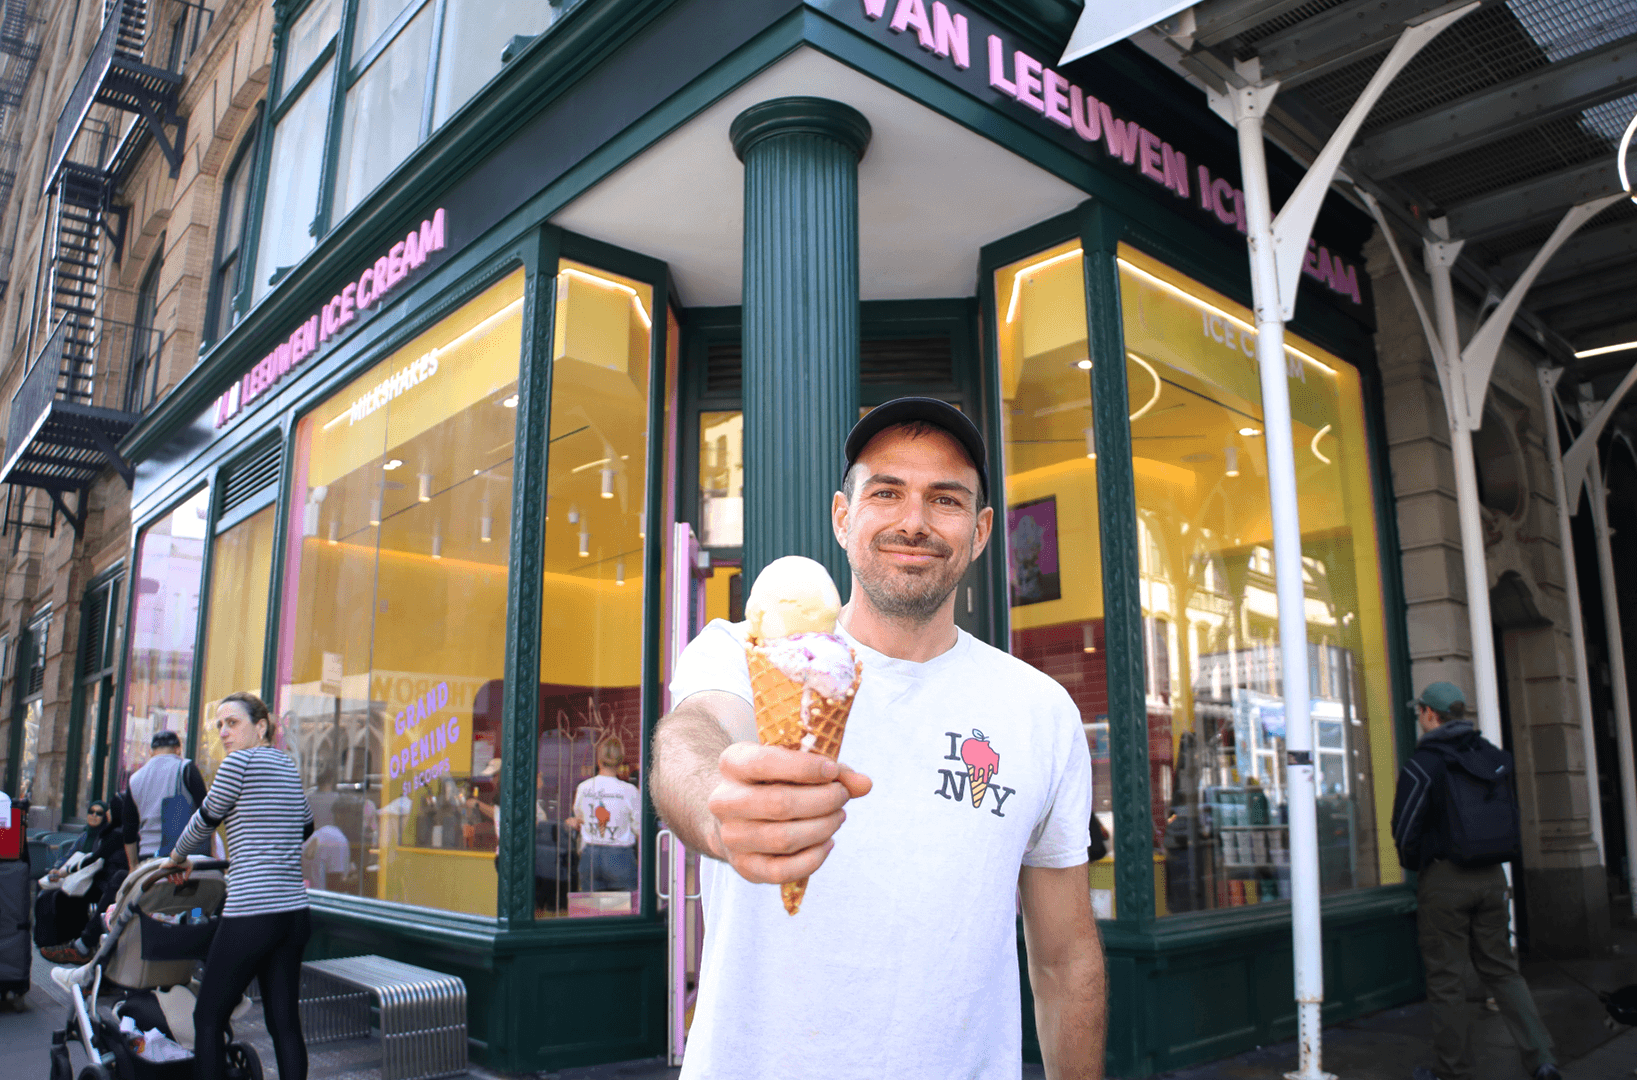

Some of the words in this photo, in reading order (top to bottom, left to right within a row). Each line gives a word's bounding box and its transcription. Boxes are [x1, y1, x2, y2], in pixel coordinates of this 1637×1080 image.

[987, 34, 1189, 198] LEEUWEN
[241, 314, 318, 406] LEEUWEN
[319, 281, 357, 342] ICE
[356, 207, 446, 310] CREAM
[1203, 310, 1237, 351] ICE
[349, 348, 438, 426] MILKSHAKES
[395, 681, 448, 736] GRAND
[390, 716, 460, 779] OPENING
[413, 757, 450, 791] SCOOPS
[944, 732, 962, 761] I
